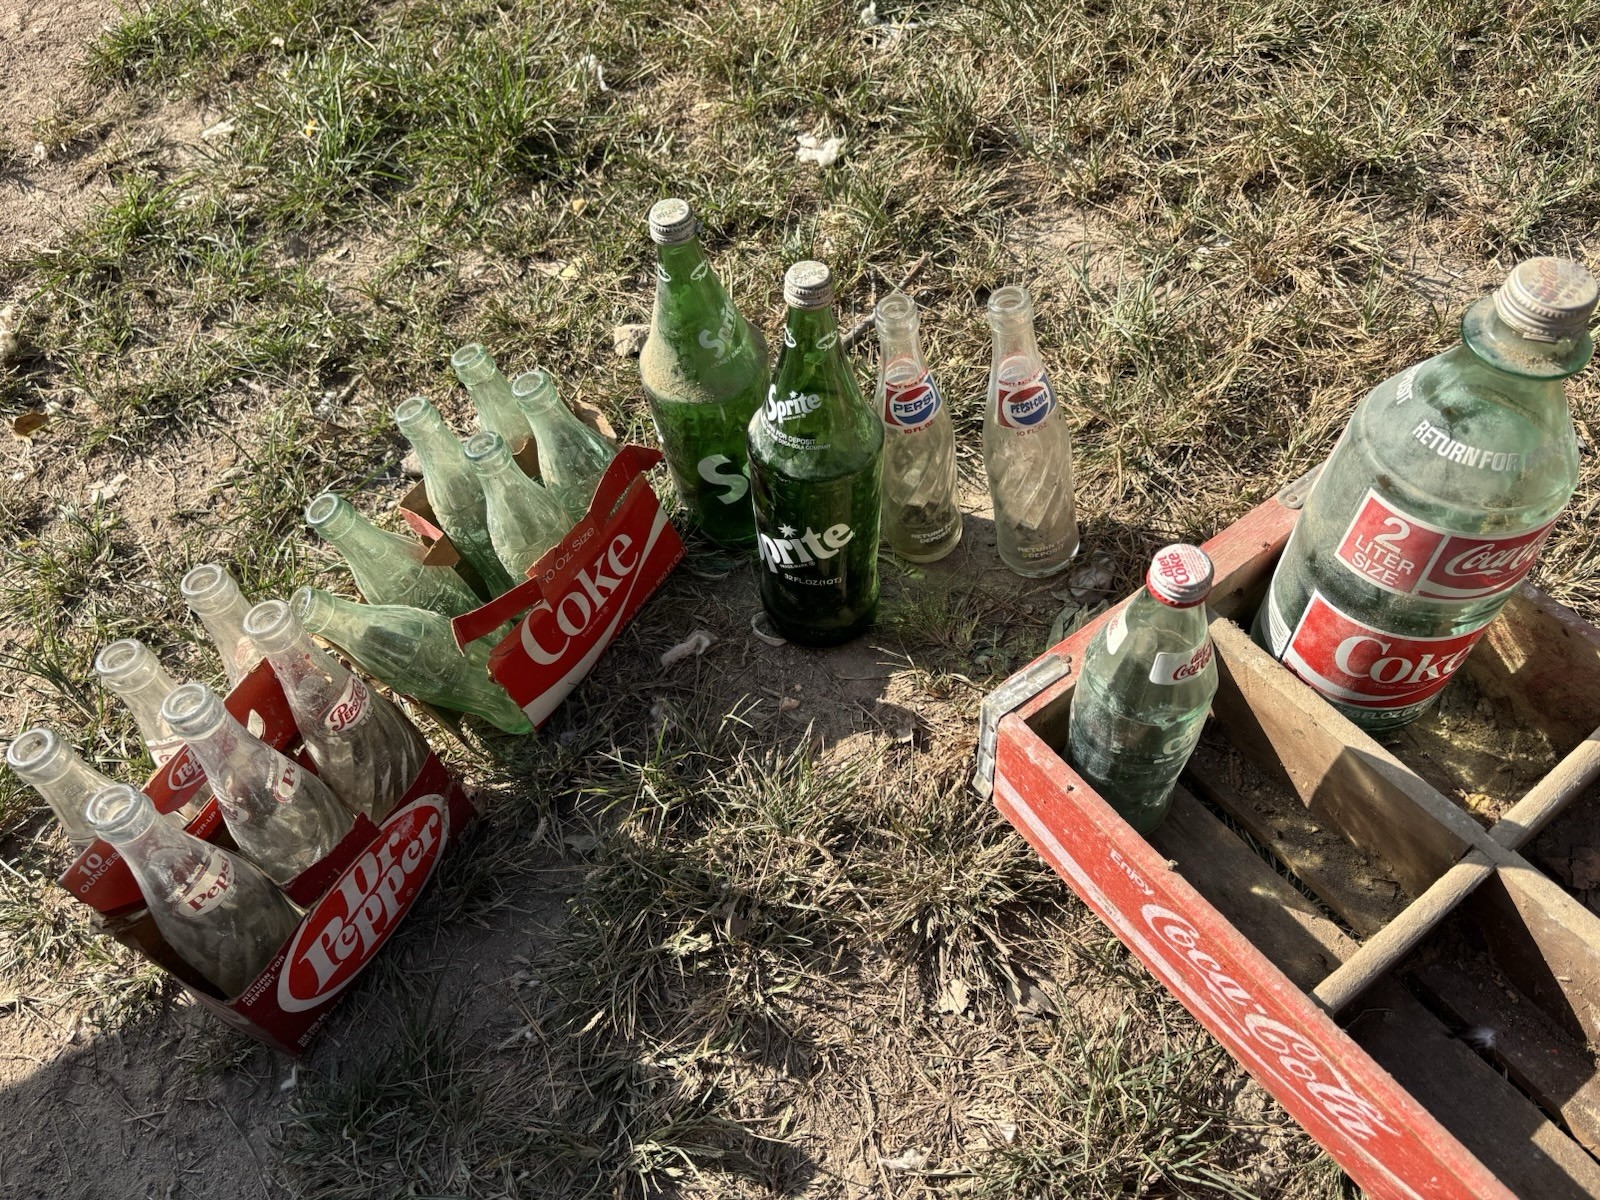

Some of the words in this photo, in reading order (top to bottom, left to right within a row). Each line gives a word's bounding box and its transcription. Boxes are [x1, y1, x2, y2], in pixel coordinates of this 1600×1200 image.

[766, 384, 822, 424] Sprite
[893, 390, 934, 413] PEPSI
[1010, 390, 1048, 414] PEPSI-COLA
[778, 438, 805, 450] COCA-COLA
[788, 435, 816, 446] DEPOSIT
[1412, 420, 1482, 468] RETURN
[1478, 450, 1520, 472] FOR
[572, 527, 595, 552] Size
[911, 528, 946, 540] RETURN
[1017, 542, 1055, 554] RETURN
[1028, 543, 1064, 558] DEPOSIT
[1373, 517, 1411, 553] 2
[1158, 555, 1175, 578] diet
[1168, 552, 1190, 585] Coke
[1351, 551, 1400, 586] SIZE
[1354, 534, 1415, 576] LITER
[784, 573, 794, 582] 32
[521, 533, 639, 666] Coke
[1335, 635, 1475, 684] Coke
[77, 853, 103, 877] 10
[79, 852, 122, 893] OUNCES
[333, 831, 401, 923] Dr
[1109, 848, 1155, 896] Enjoy
[187, 854, 231, 912] Pepsi
[297, 812, 439, 995] Pepper
[242, 974, 271, 1003] RETURN
[271, 955, 285, 973] FOR
[245, 975, 275, 1007] DEPOSIT
[1140, 902, 1399, 1142] Coca-Cola
